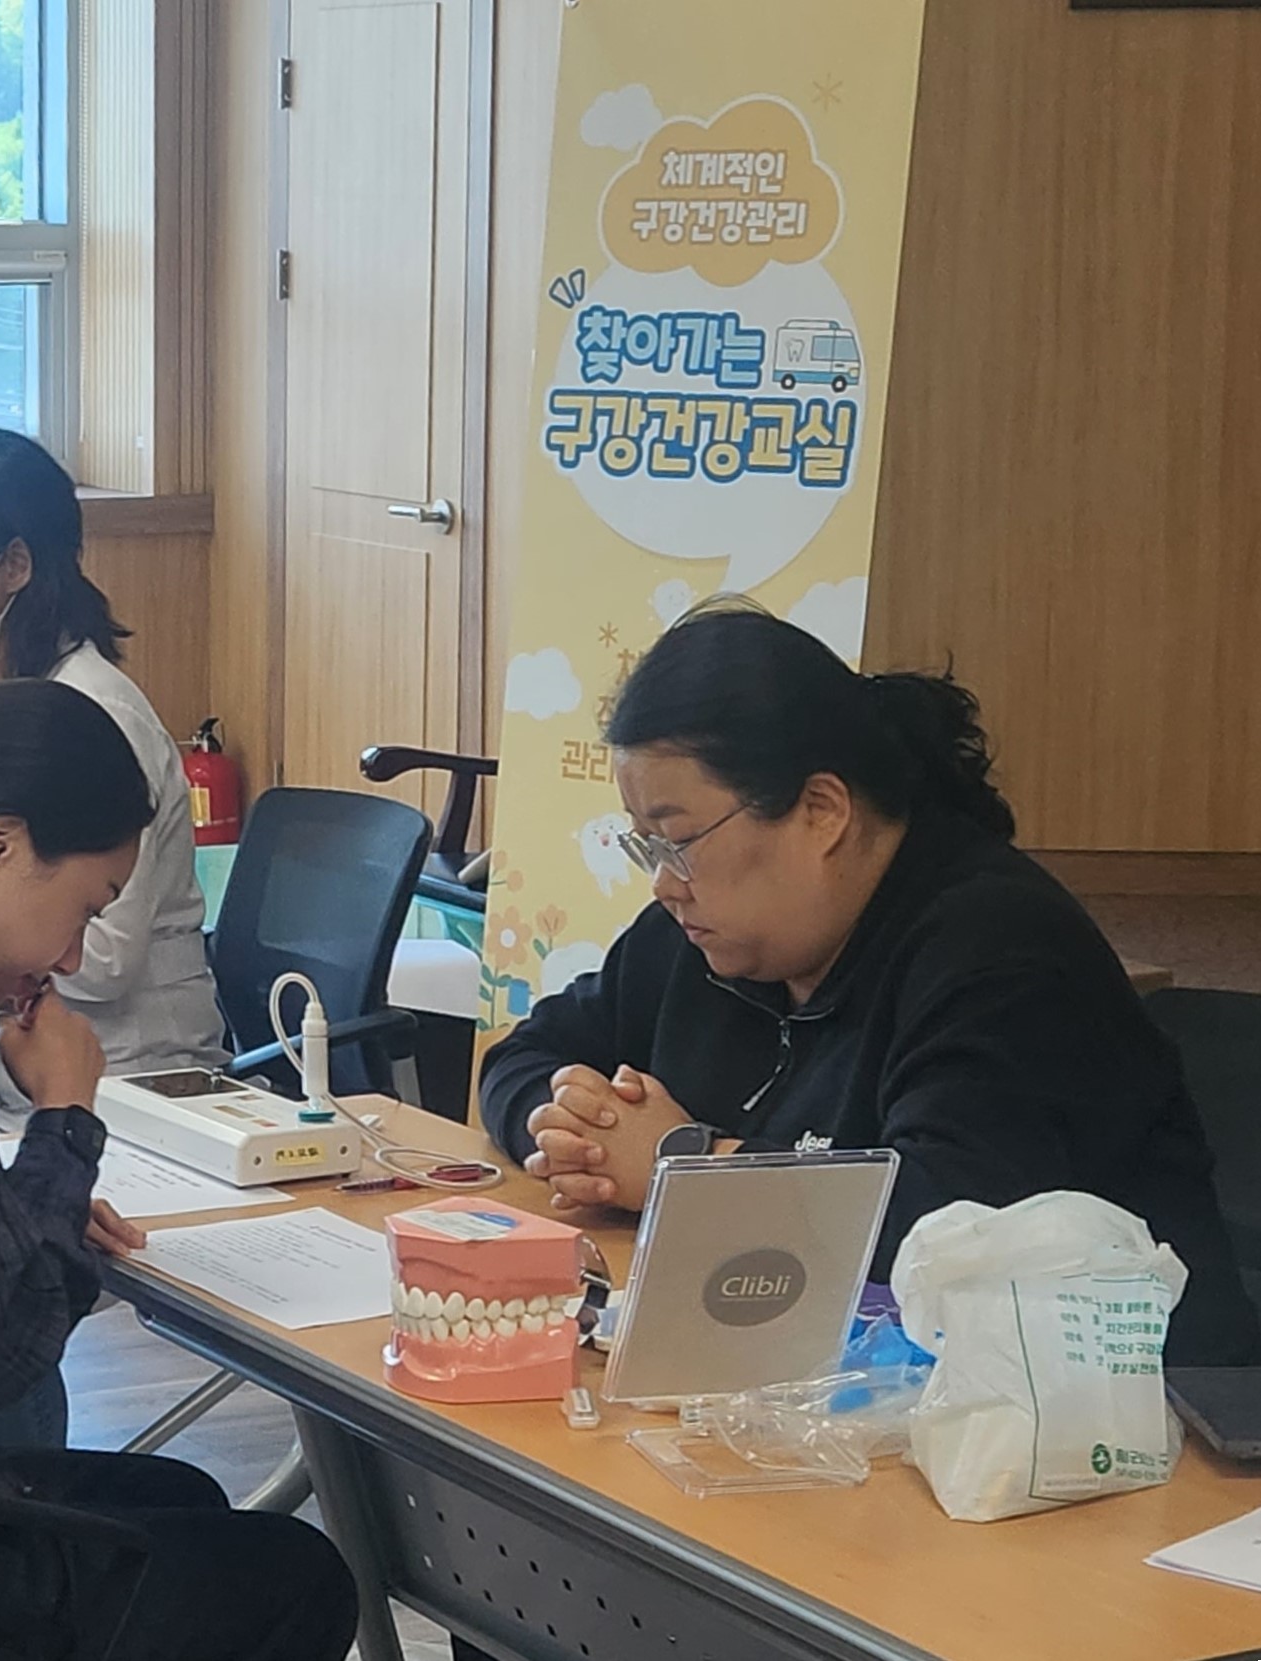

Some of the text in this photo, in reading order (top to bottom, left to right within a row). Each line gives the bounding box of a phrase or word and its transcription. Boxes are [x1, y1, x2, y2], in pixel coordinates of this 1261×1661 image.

[661, 150, 785, 194] 체계적인
[632, 200, 808, 244] 구강건강관리
[577, 307, 764, 387] 찾아가는
[547, 391, 856, 486] 구강건강교실
[721, 1275, 791, 1297] Clibli
